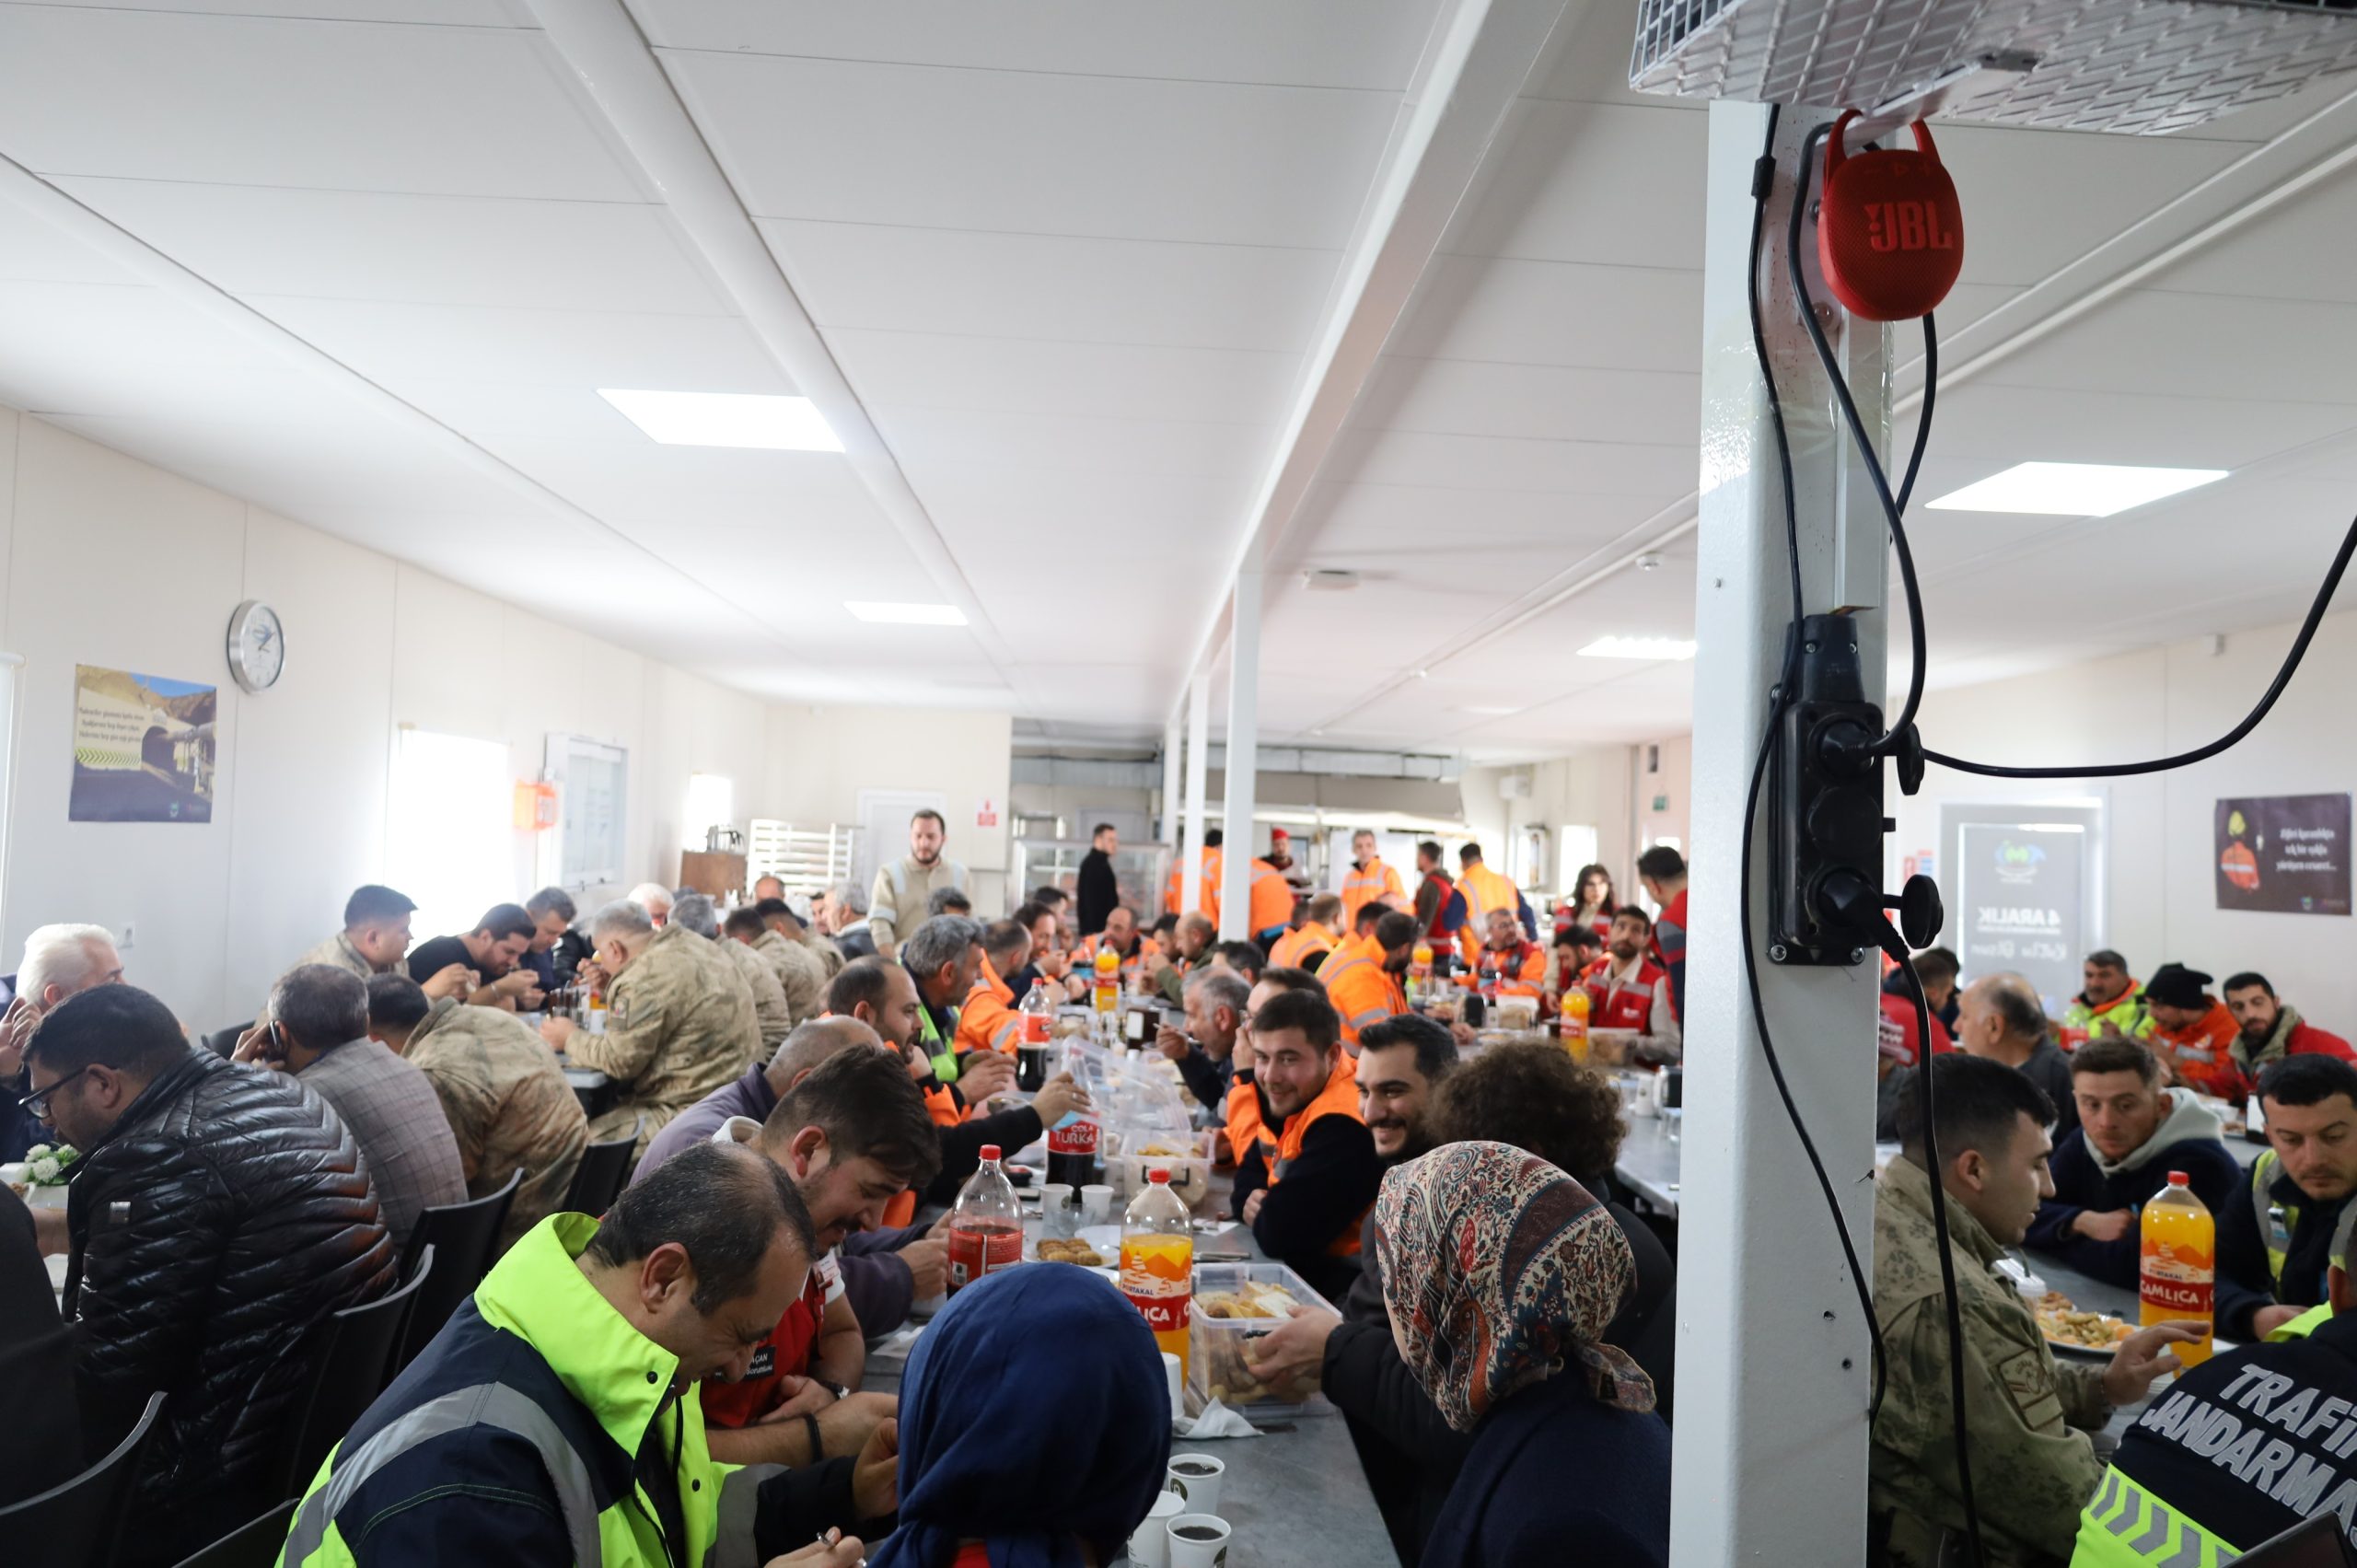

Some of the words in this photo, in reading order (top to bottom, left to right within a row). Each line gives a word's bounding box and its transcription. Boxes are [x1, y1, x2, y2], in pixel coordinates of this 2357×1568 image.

[1865, 201, 1954, 252] JBL
[1072, 1124, 1093, 1132] COLA
[1055, 1131, 1094, 1144] TURKA
